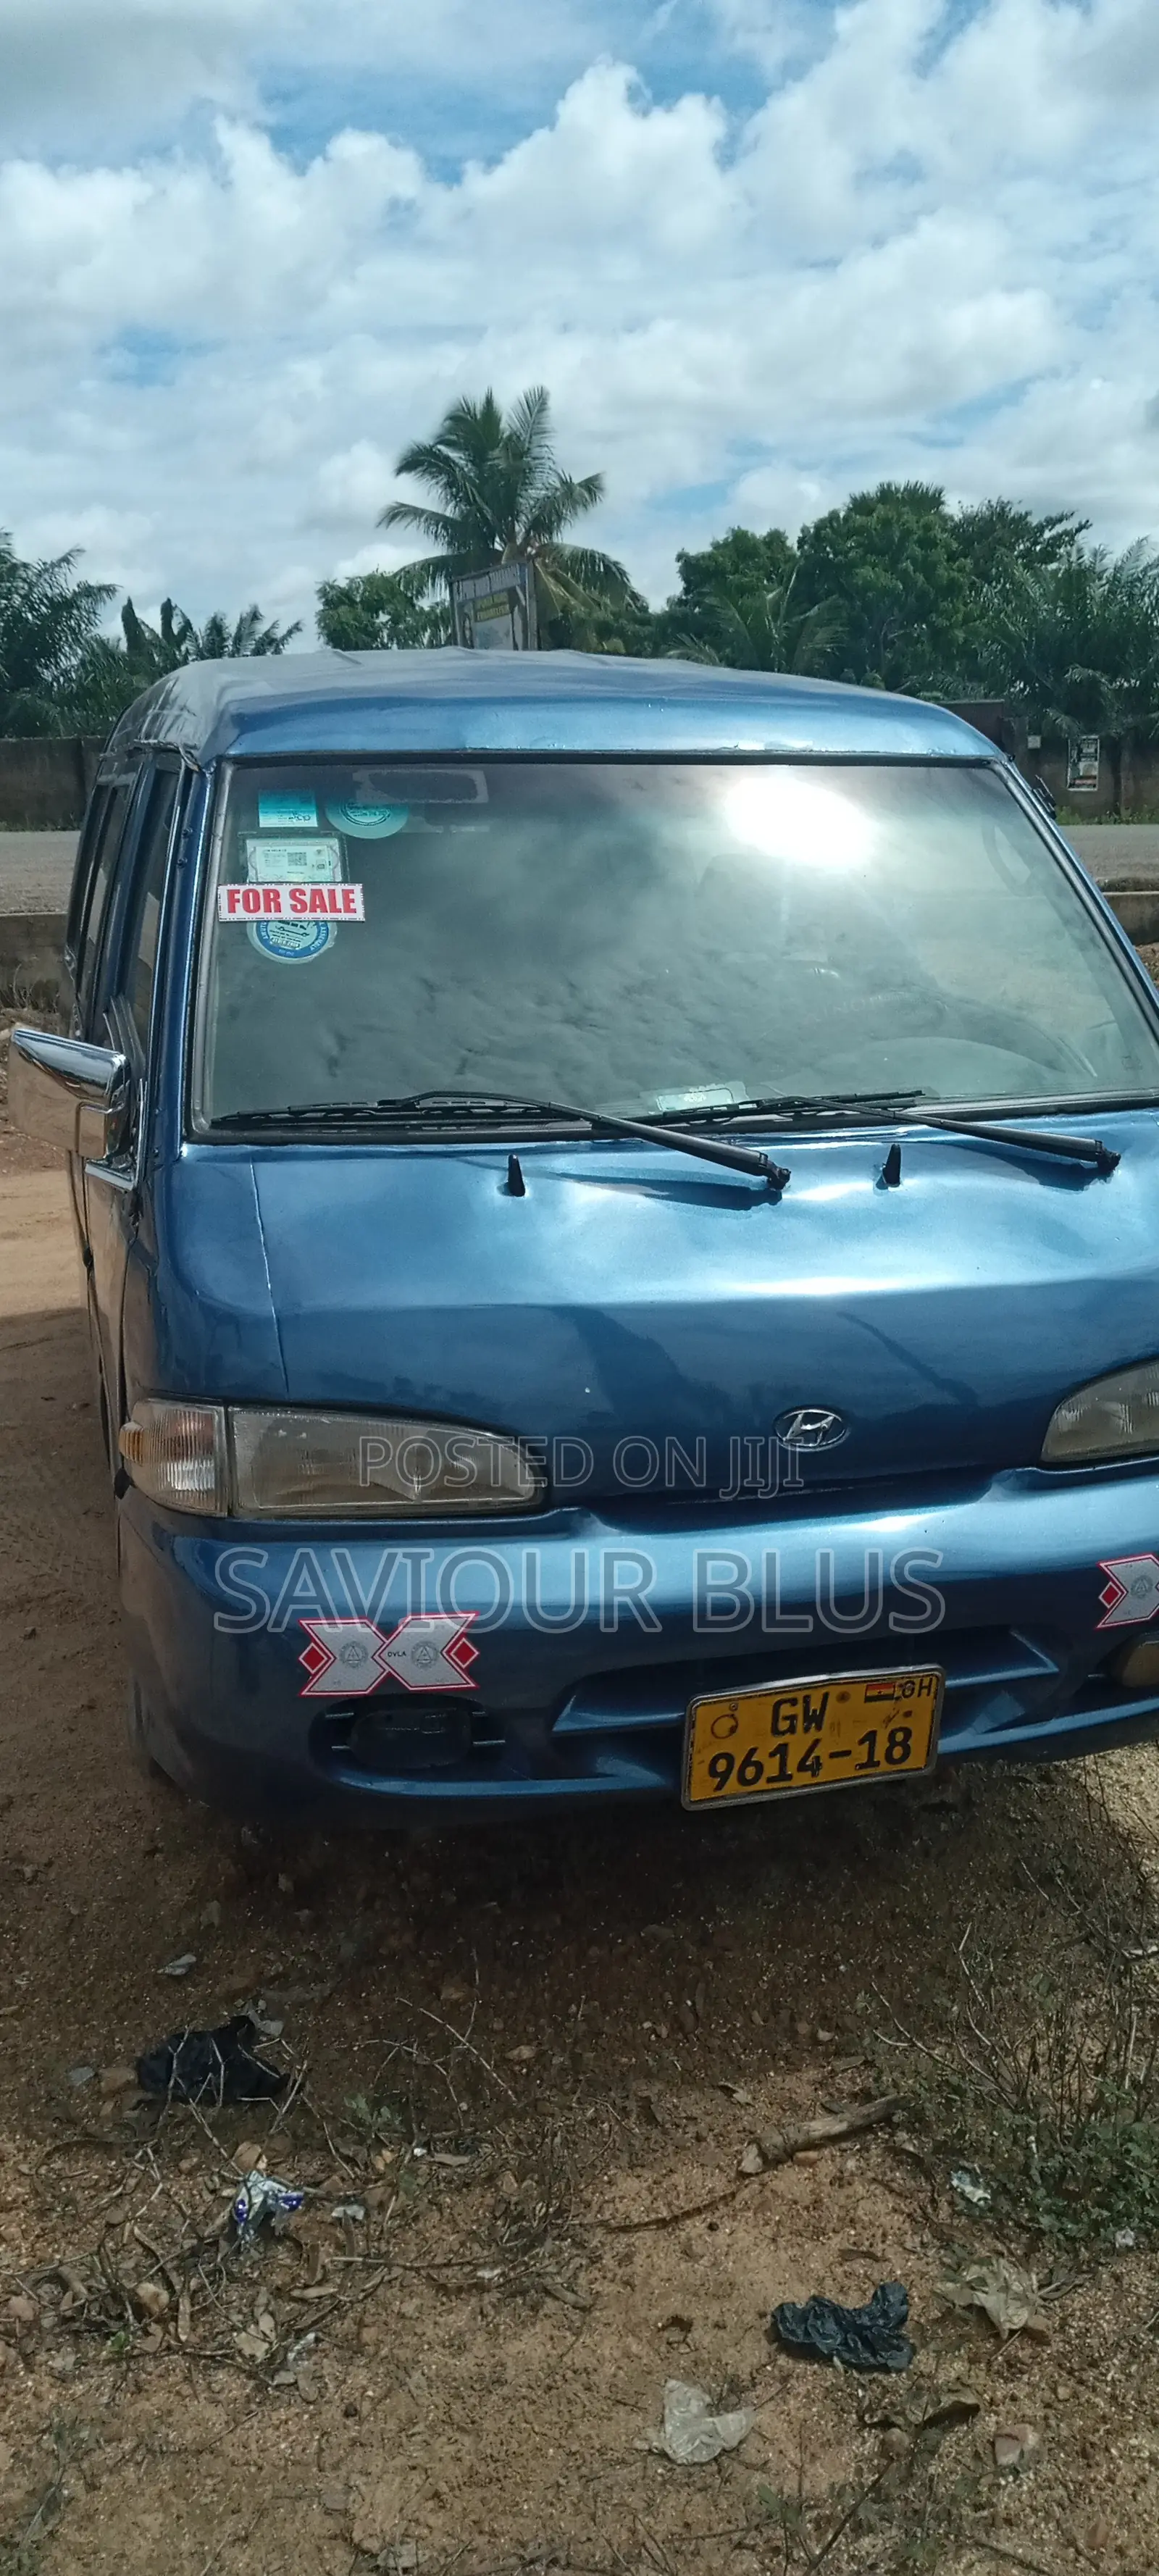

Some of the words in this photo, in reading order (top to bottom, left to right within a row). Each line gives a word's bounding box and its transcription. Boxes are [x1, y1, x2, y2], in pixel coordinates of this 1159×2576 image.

[227, 888, 281, 913] FOR
[290, 888, 357, 913] SALE
[771, 1691, 829, 1737] GW
[708, 1727, 913, 1791] 9614-18
